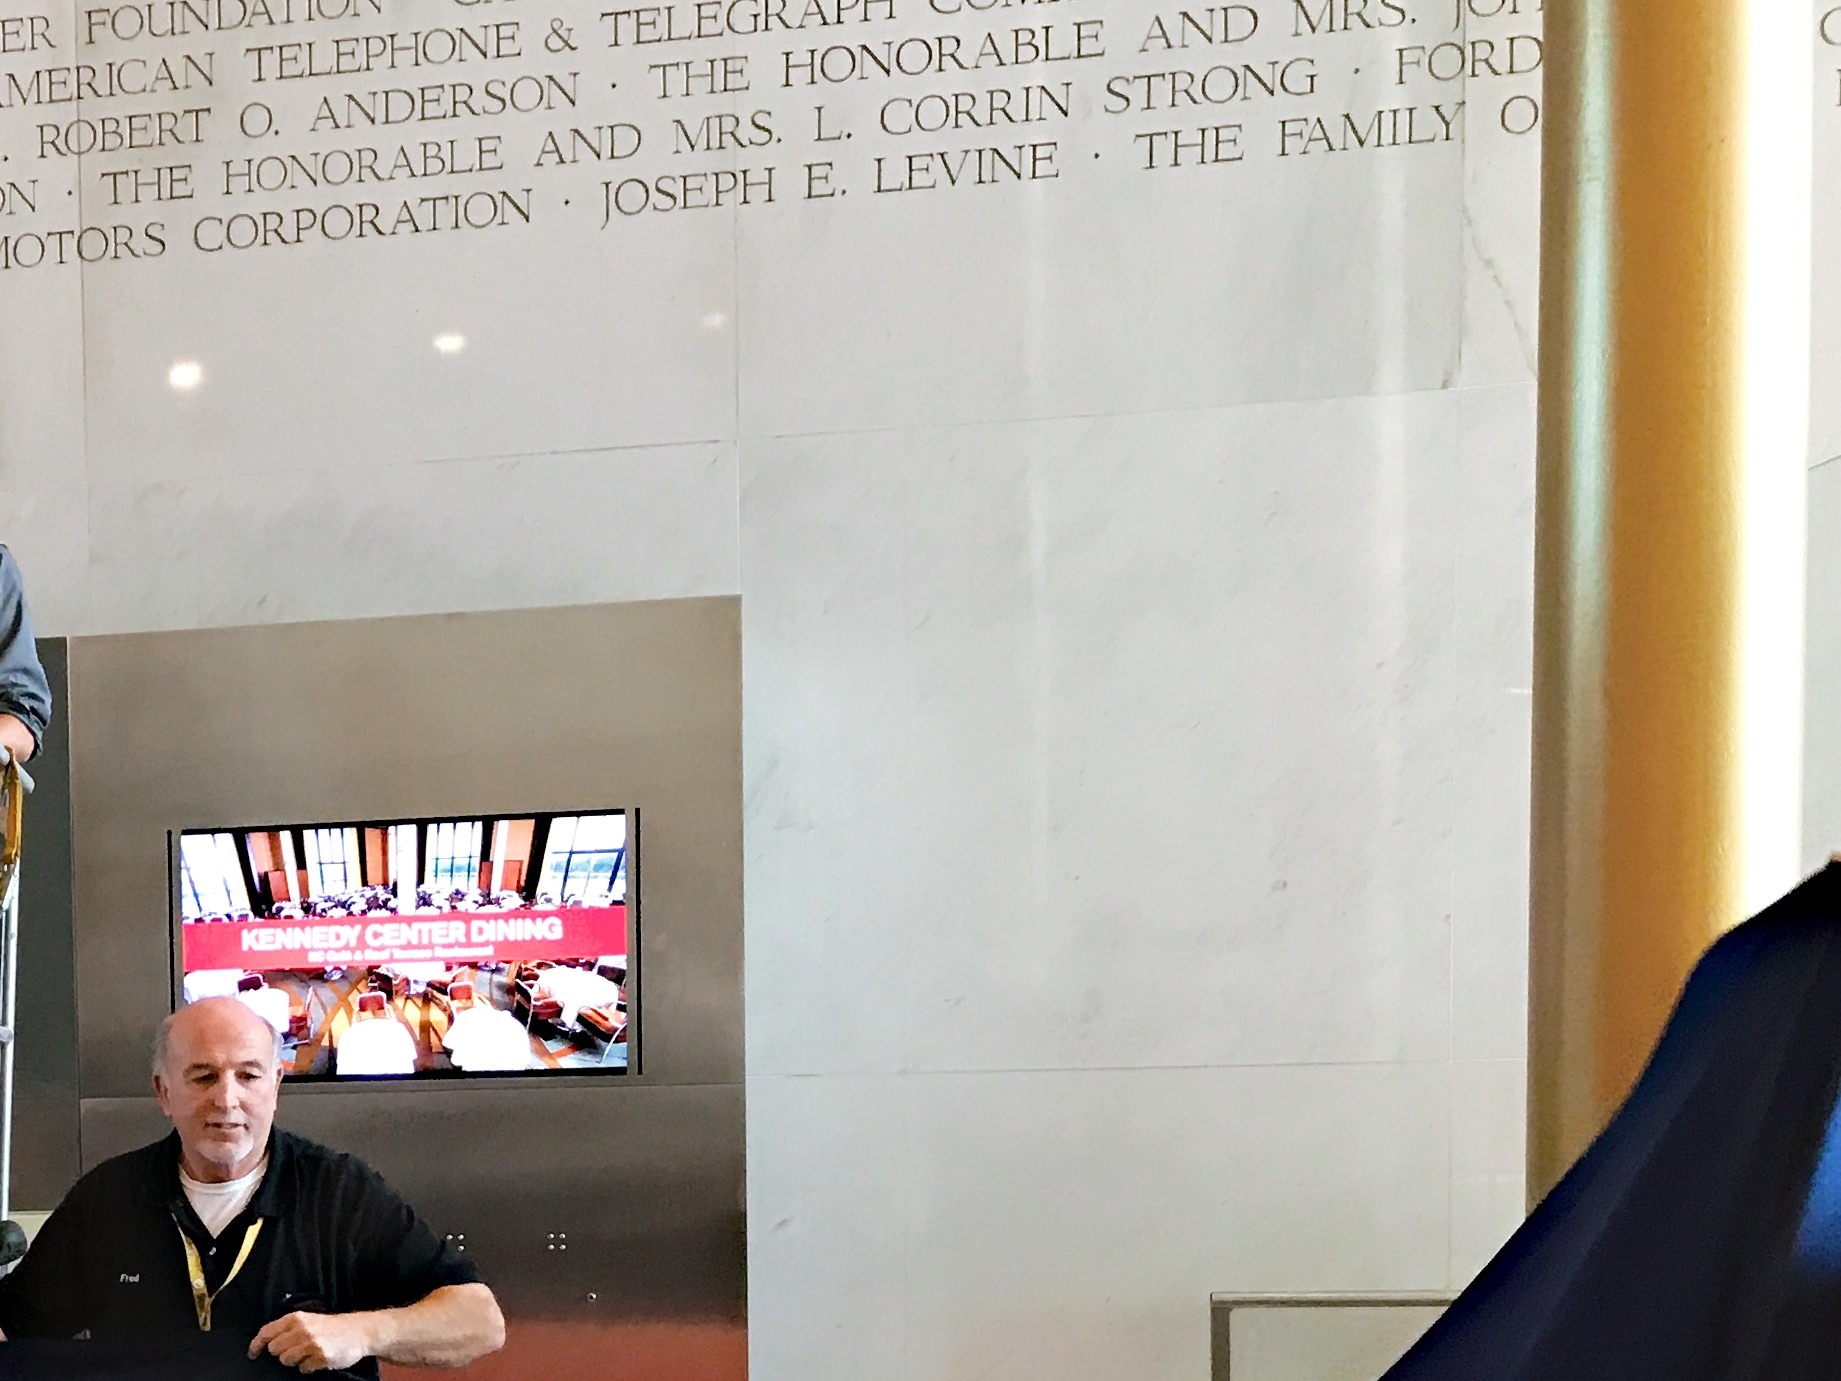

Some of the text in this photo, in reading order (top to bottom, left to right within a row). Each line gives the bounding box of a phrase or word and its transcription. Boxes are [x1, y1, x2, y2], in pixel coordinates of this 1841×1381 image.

[36, 107, 213, 160] ROBERT
[239, 102, 281, 139] O.
[309, 72, 581, 133] ANDERSON
[648, 55, 752, 100] THE
[780, 19, 1107, 88] HONORABLE
[1137, 5, 1261, 53] AND
[1290, 0, 1418, 37] MRS.
[100, 164, 195, 206] THE
[221, 135, 505, 196] HONORABLE
[533, 123, 643, 168] AND
[671, 109, 783, 155] MRS.
[814, 106, 854, 142] L.
[879, 82, 1074, 136] CORRIN
[1103, 57, 1318, 115] STRONG
[1395, 34, 1542, 85] FORD
[243, 21, 523, 84] TELEPHONE
[544, 17, 579, 53] &
[192, 187, 534, 254] CORPORATION
[601, 166, 777, 230] JOSEPH
[802, 160, 848, 201] E.
[872, 142, 1061, 195] LEVINE
[1133, 124, 1245, 171] THE
[1278, 100, 1467, 158] FAMILY
[241, 915, 564, 953] KENNEDY CENTER DINING
